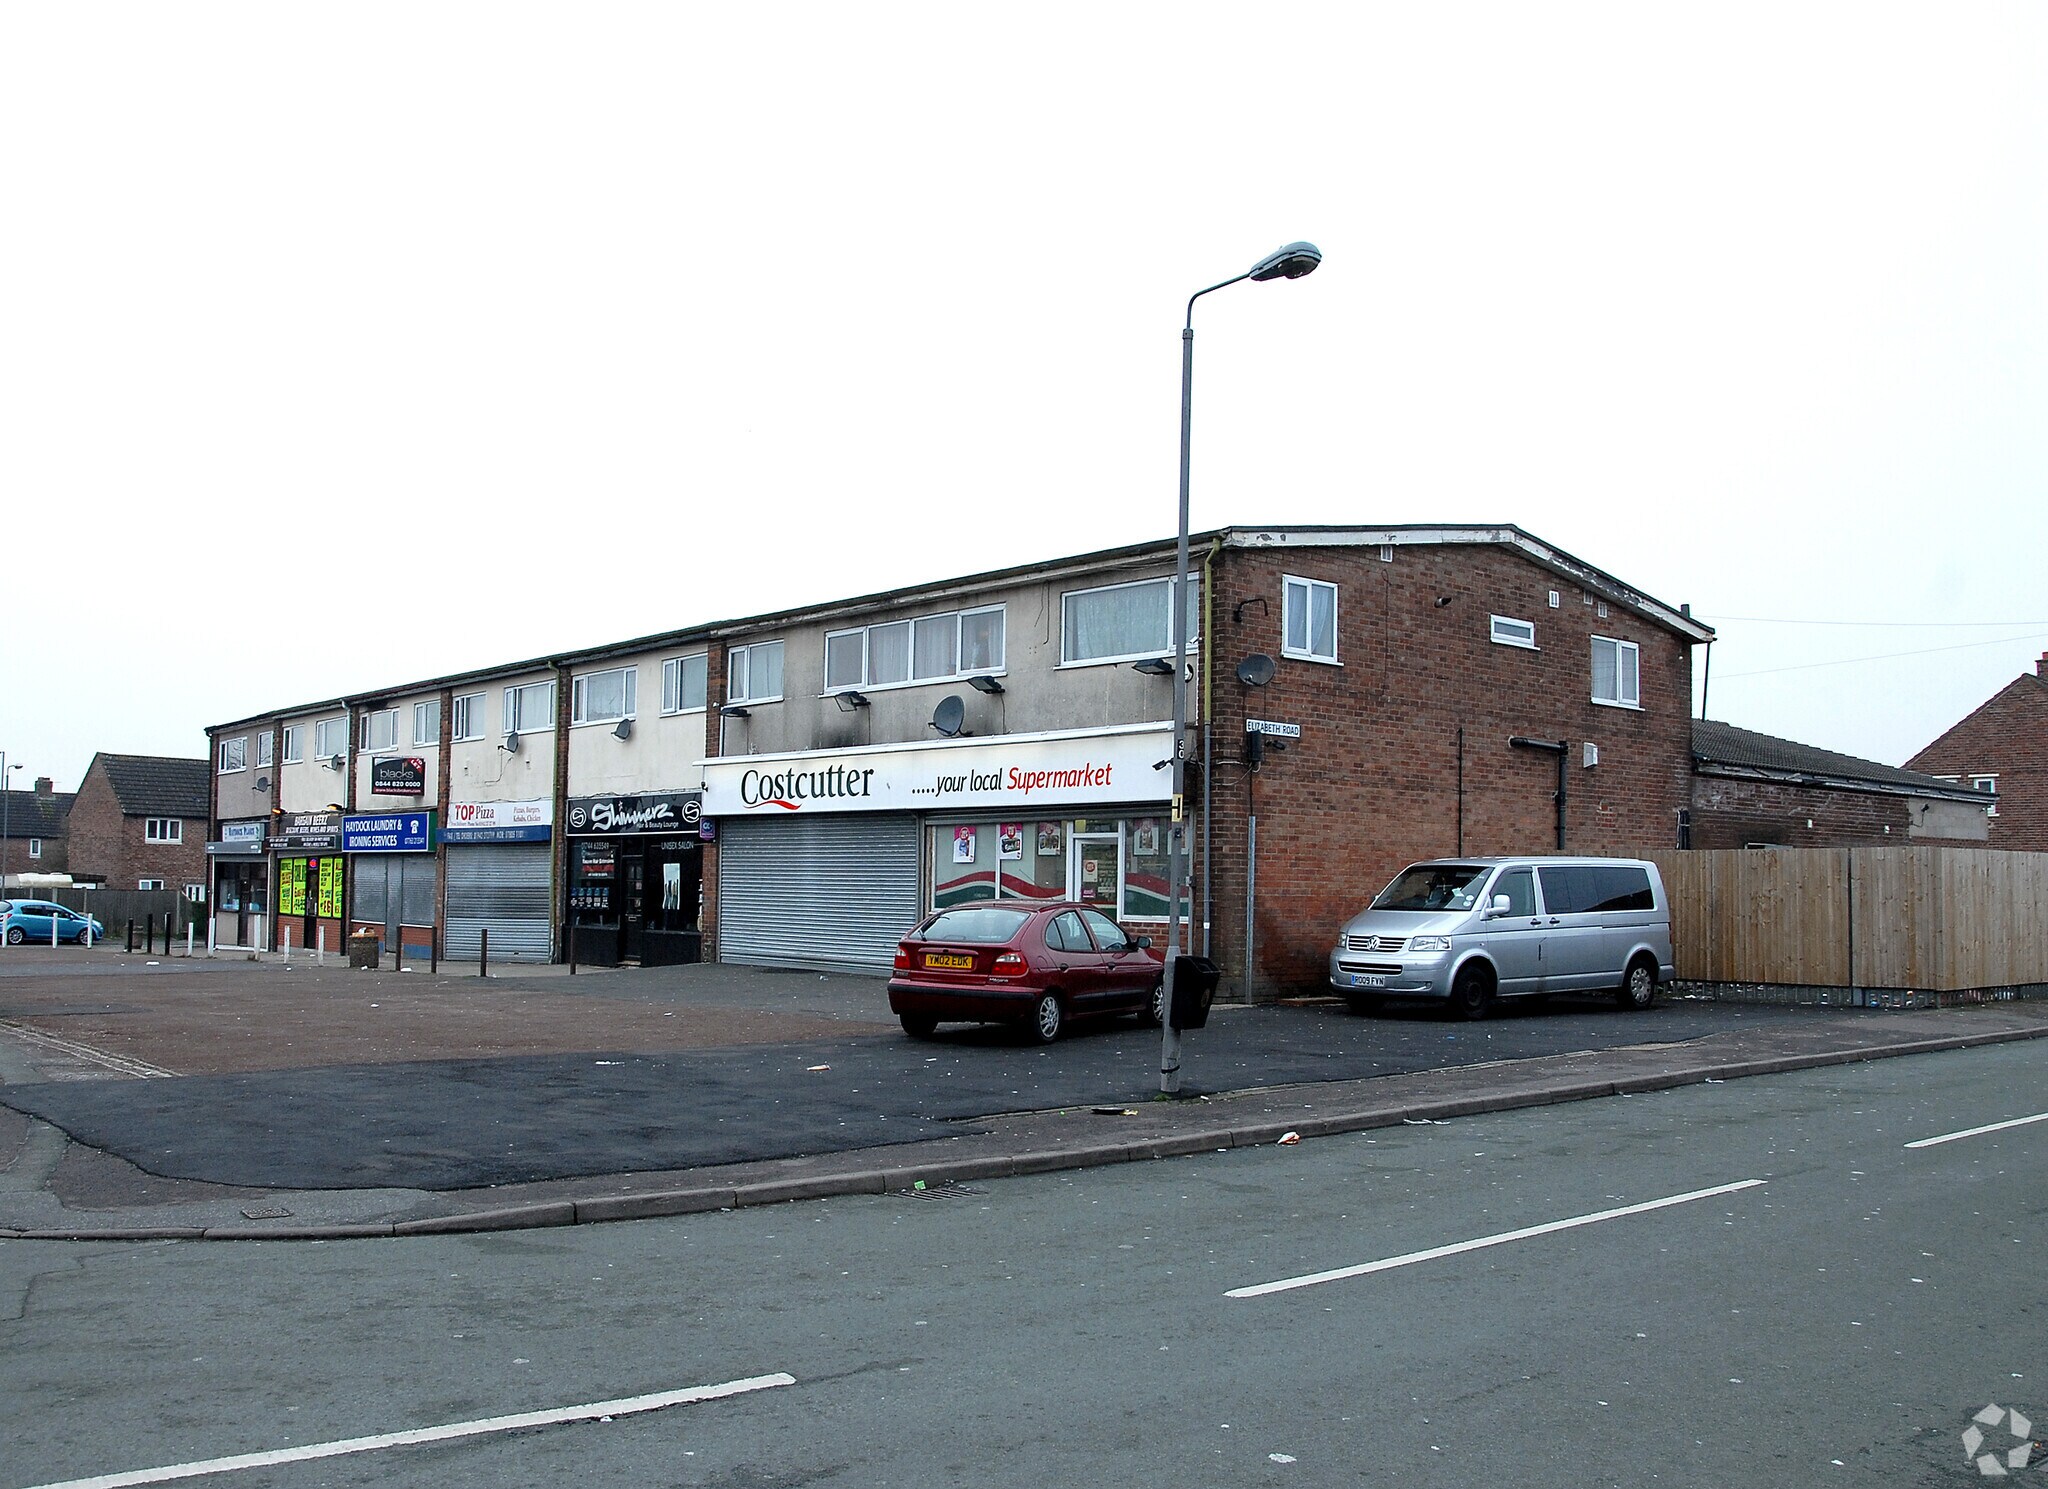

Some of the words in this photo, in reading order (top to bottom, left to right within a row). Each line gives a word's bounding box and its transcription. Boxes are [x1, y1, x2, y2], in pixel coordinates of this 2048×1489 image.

[1248, 721, 1280, 733] ELIZABETH
[1282, 726, 1299, 735] ROAD
[380, 763, 414, 778] blacks
[741, 764, 874, 805] Costcutter
[970, 768, 1002, 791] local
[1007, 763, 1112, 794] Supermarket
[455, 805, 475, 820] TOP
[475, 805, 495, 819] Pizza
[591, 801, 674, 830] Shimmerz
[345, 820, 370, 832] HAYDOCK
[371, 819, 397, 832] LAUNDRY
[397, 819, 402, 830] &
[663, 821, 679, 829] Lounge
[349, 836, 371, 847] IRONING
[372, 835, 397, 846] SERVICES
[661, 842, 677, 850] UNISEX
[678, 841, 694, 849] SALON
